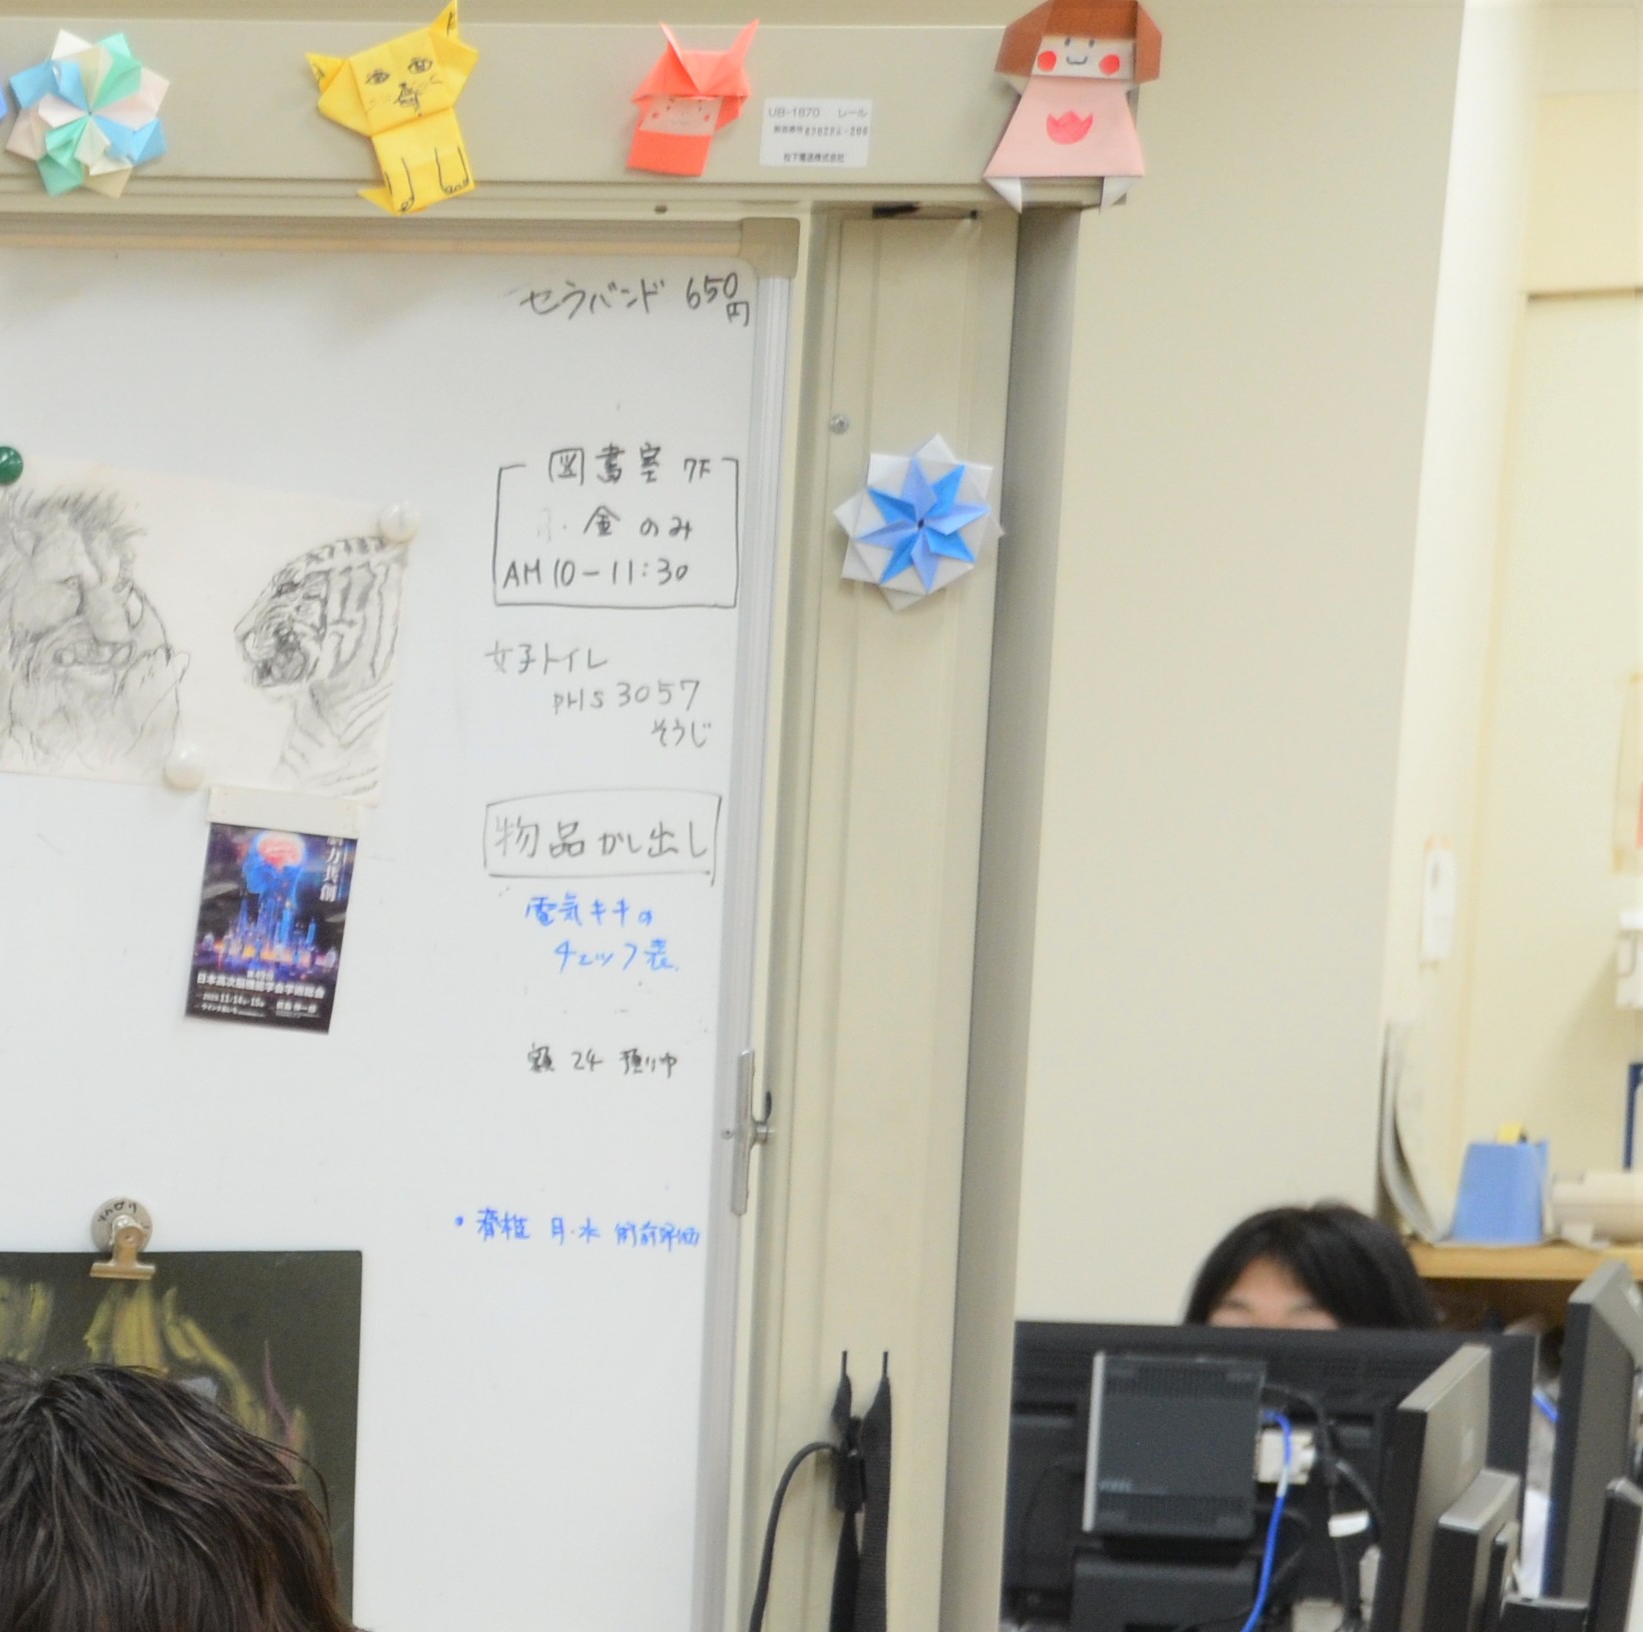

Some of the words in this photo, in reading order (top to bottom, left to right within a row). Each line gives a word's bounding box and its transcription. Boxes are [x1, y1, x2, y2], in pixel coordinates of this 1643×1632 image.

[838, 107, 868, 118] レール
[520, 276, 665, 319] セラバンド
[684, 271, 751, 327] 650円
[549, 442, 661, 486] 図書室
[484, 641, 609, 676] 女子トイレ
[553, 687, 605, 716] PHS
[615, 679, 701, 712] 3057
[651, 717, 713, 749] そうじ
[494, 816, 708, 861] 物品かし出し
[571, 1047, 604, 1072] 24
